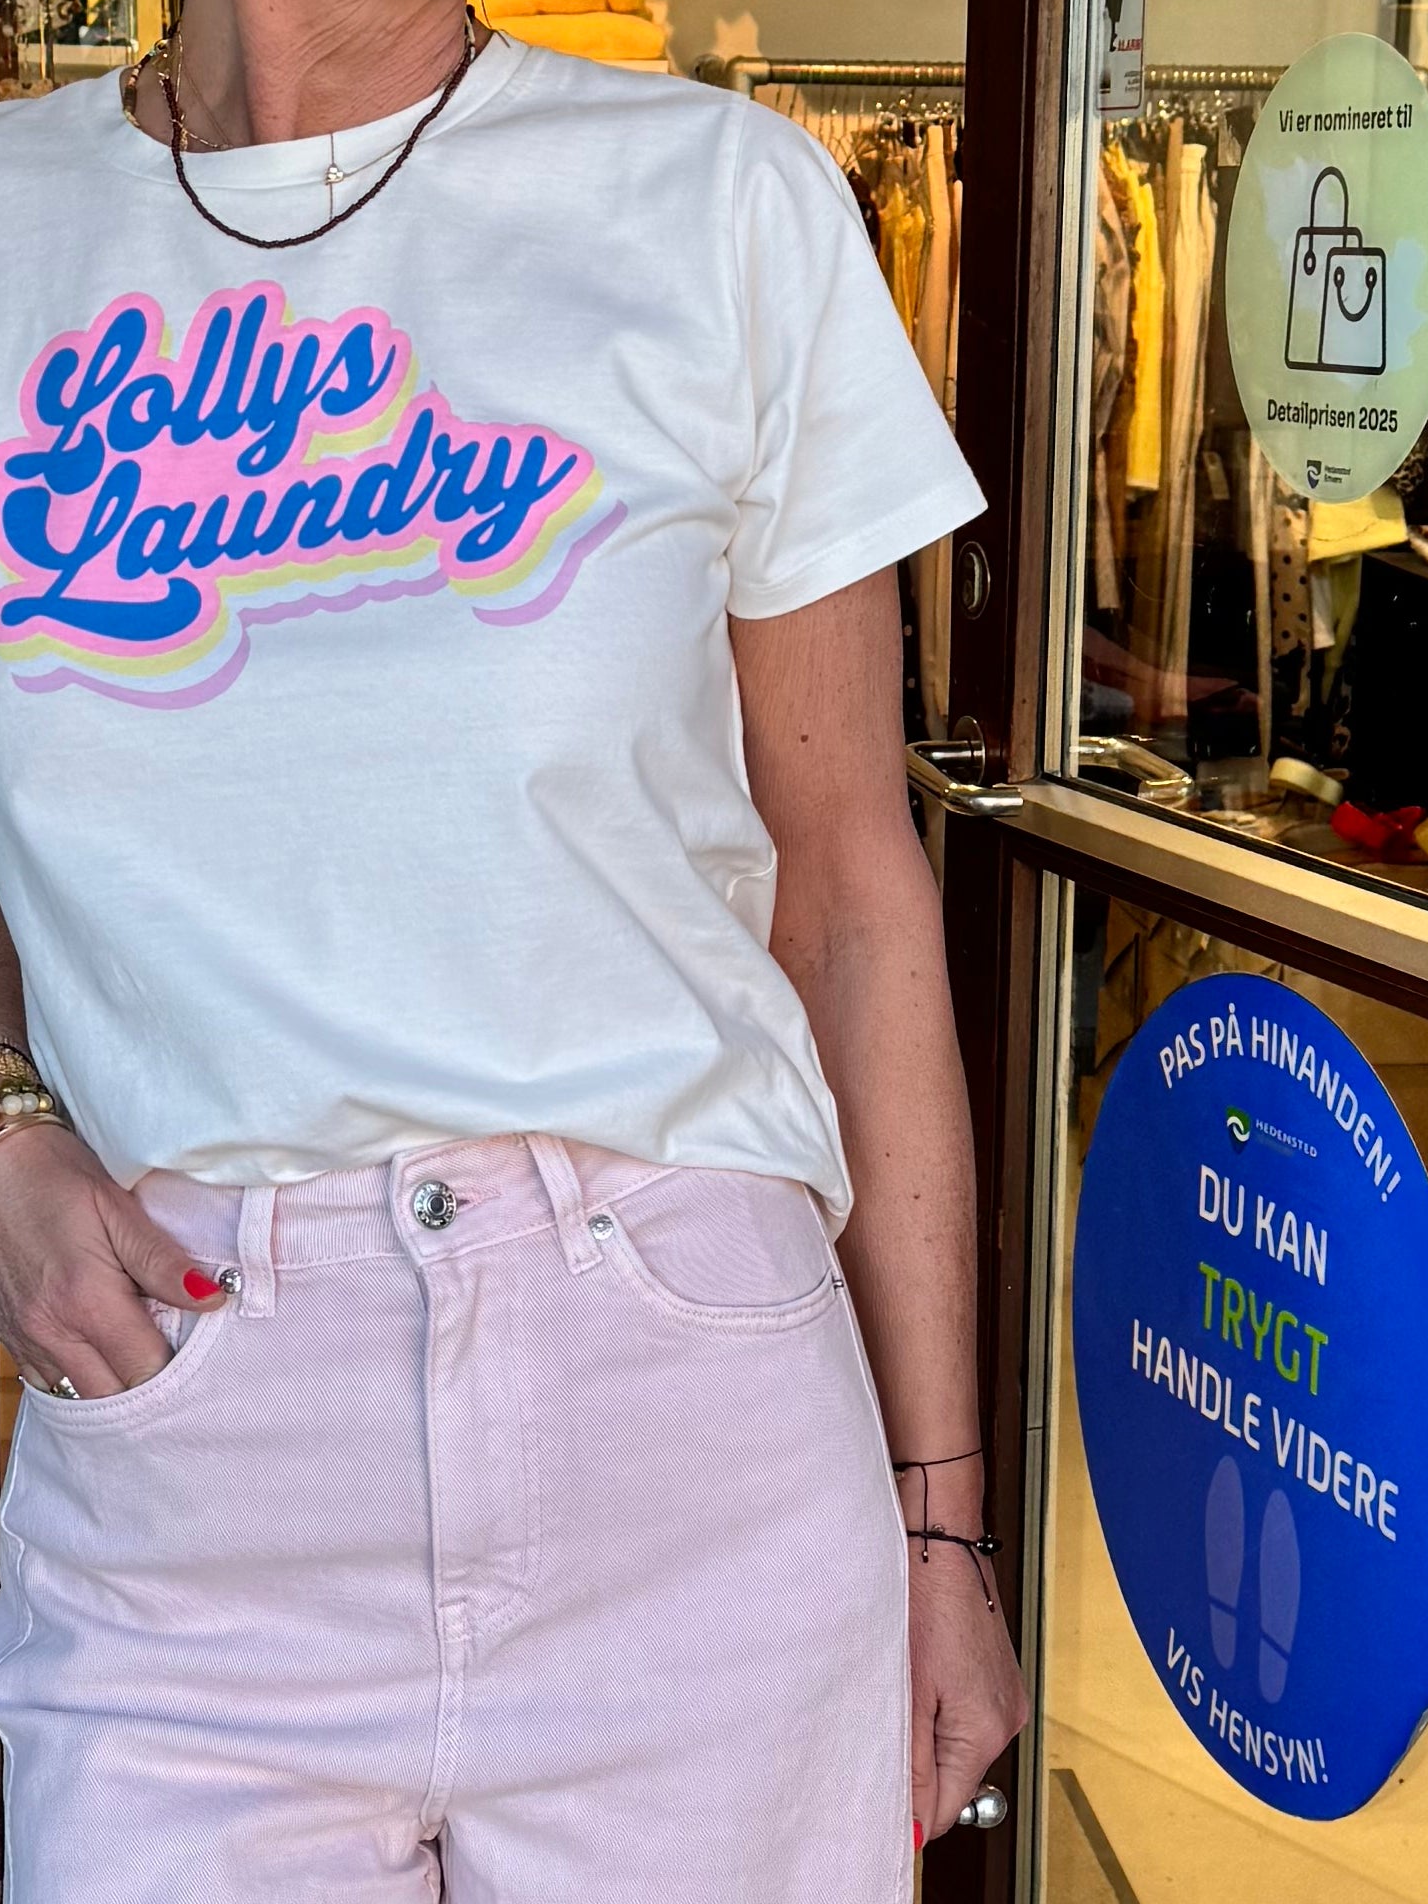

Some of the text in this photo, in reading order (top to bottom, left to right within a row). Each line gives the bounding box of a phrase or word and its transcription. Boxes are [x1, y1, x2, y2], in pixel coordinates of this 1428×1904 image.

[1278, 103, 1413, 134] Vi er nomineret til
[4, 294, 397, 495] Lollys
[1267, 398, 1399, 433] Detailprisen 2025
[2, 408, 578, 641] Laundry
[1159, 1001, 1402, 1203] PAS PÅ HINANDEN!
[1255, 1117, 1318, 1158] HEDENSTED
[1198, 1163, 1329, 1286] DU KAN
[1198, 1260, 1329, 1396] TRYGT
[1131, 1318, 1400, 1542] HANDLE VIDERE
[1166, 1627, 1330, 1785] VIS HENSYN!
